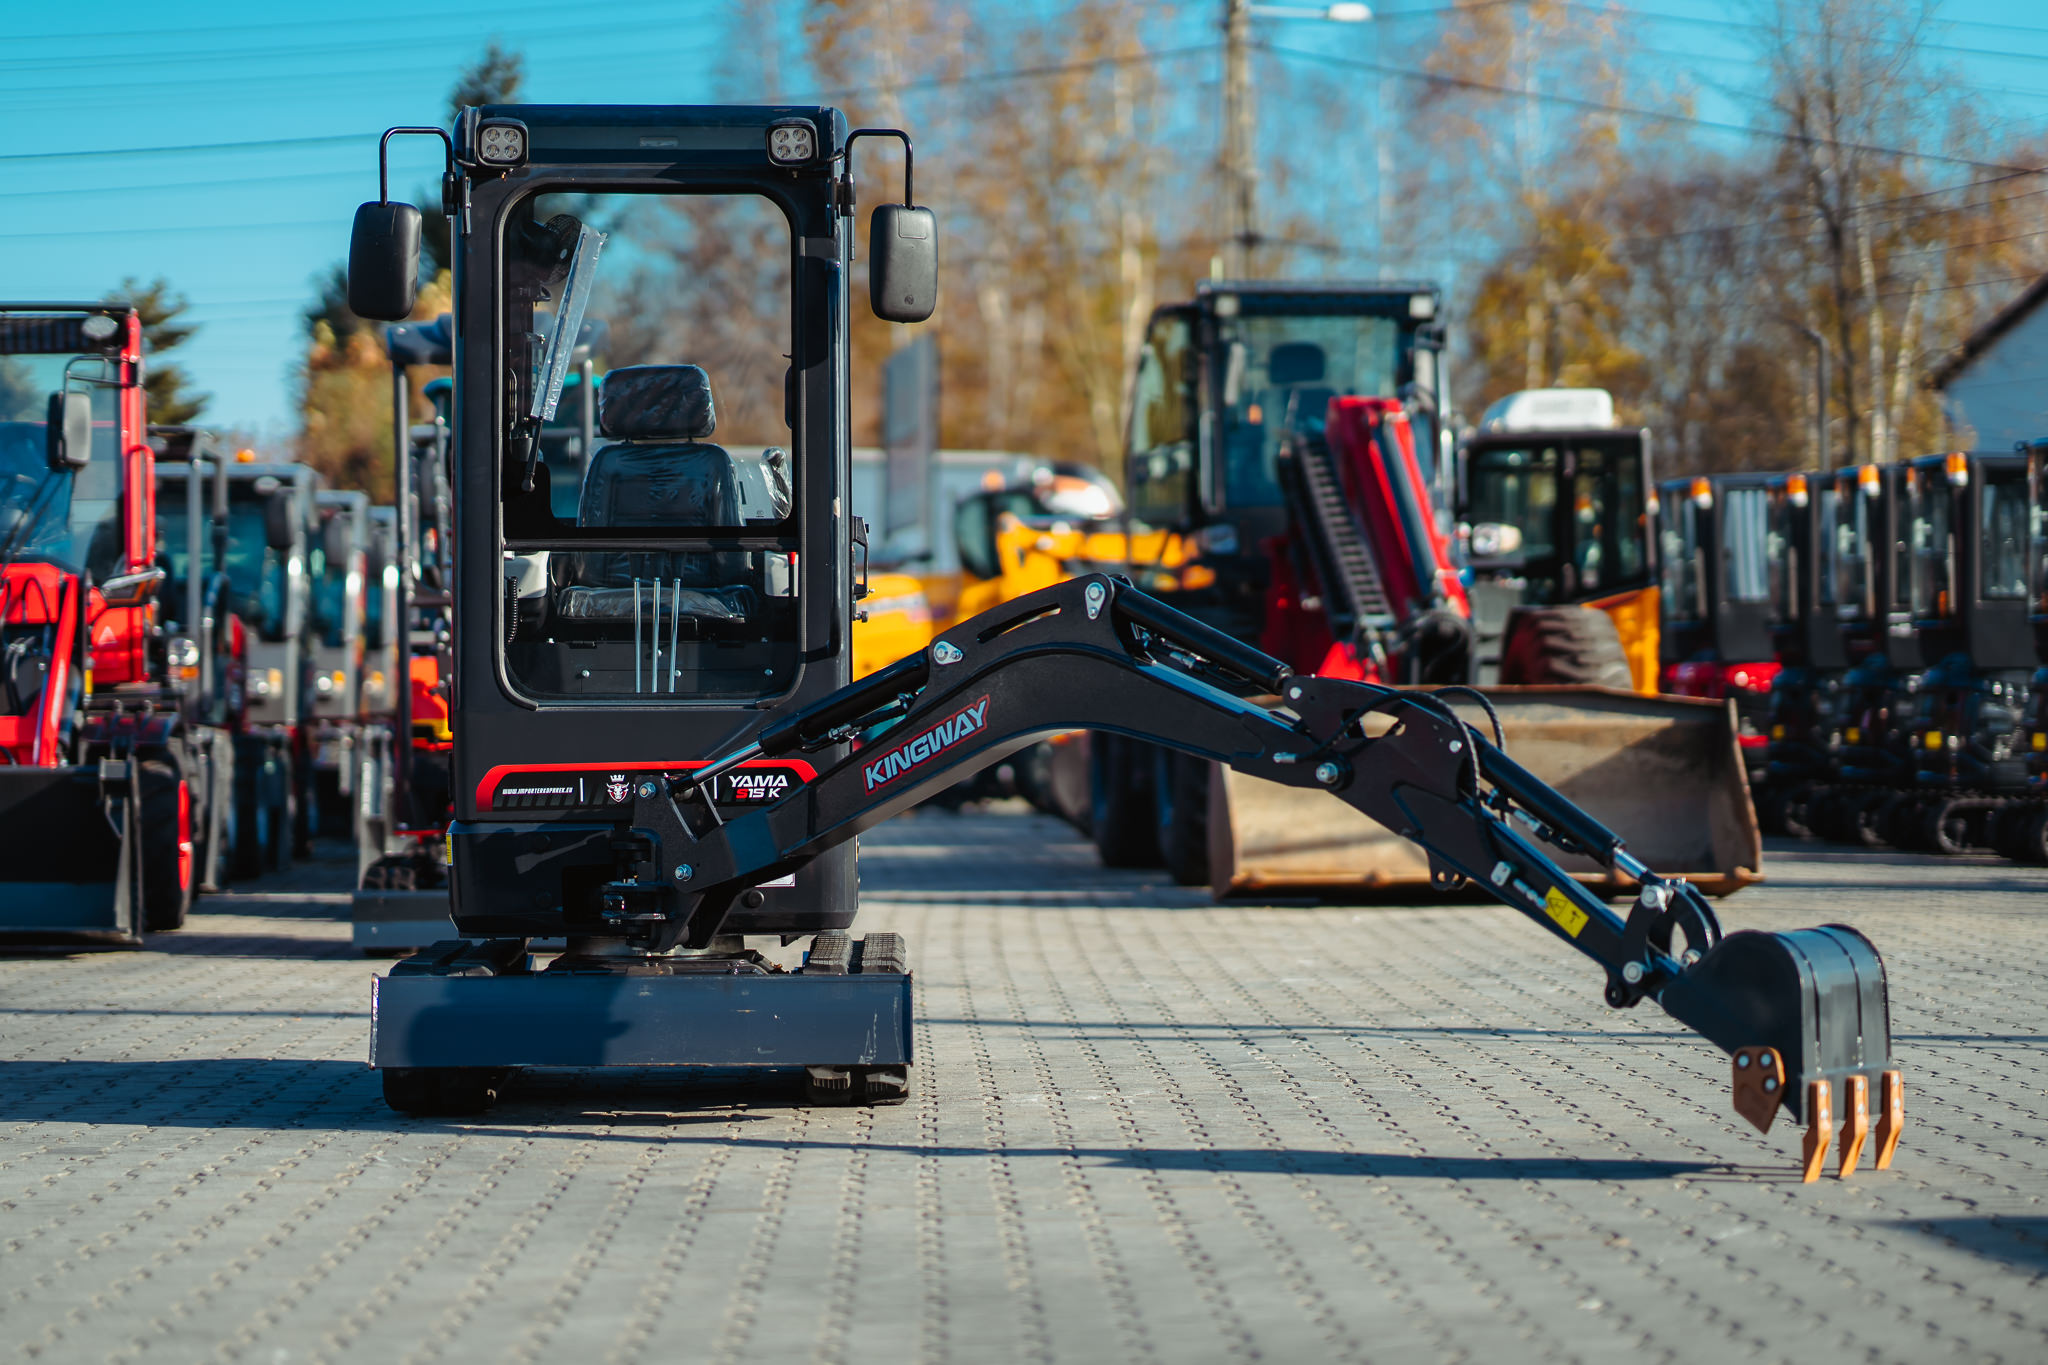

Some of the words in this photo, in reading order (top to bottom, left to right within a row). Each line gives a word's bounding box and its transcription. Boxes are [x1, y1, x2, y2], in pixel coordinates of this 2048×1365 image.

[864, 699, 987, 791] KINGWAY
[728, 774, 789, 788] YAMA
[735, 788, 766, 799] S15
[768, 787, 782, 798] K
